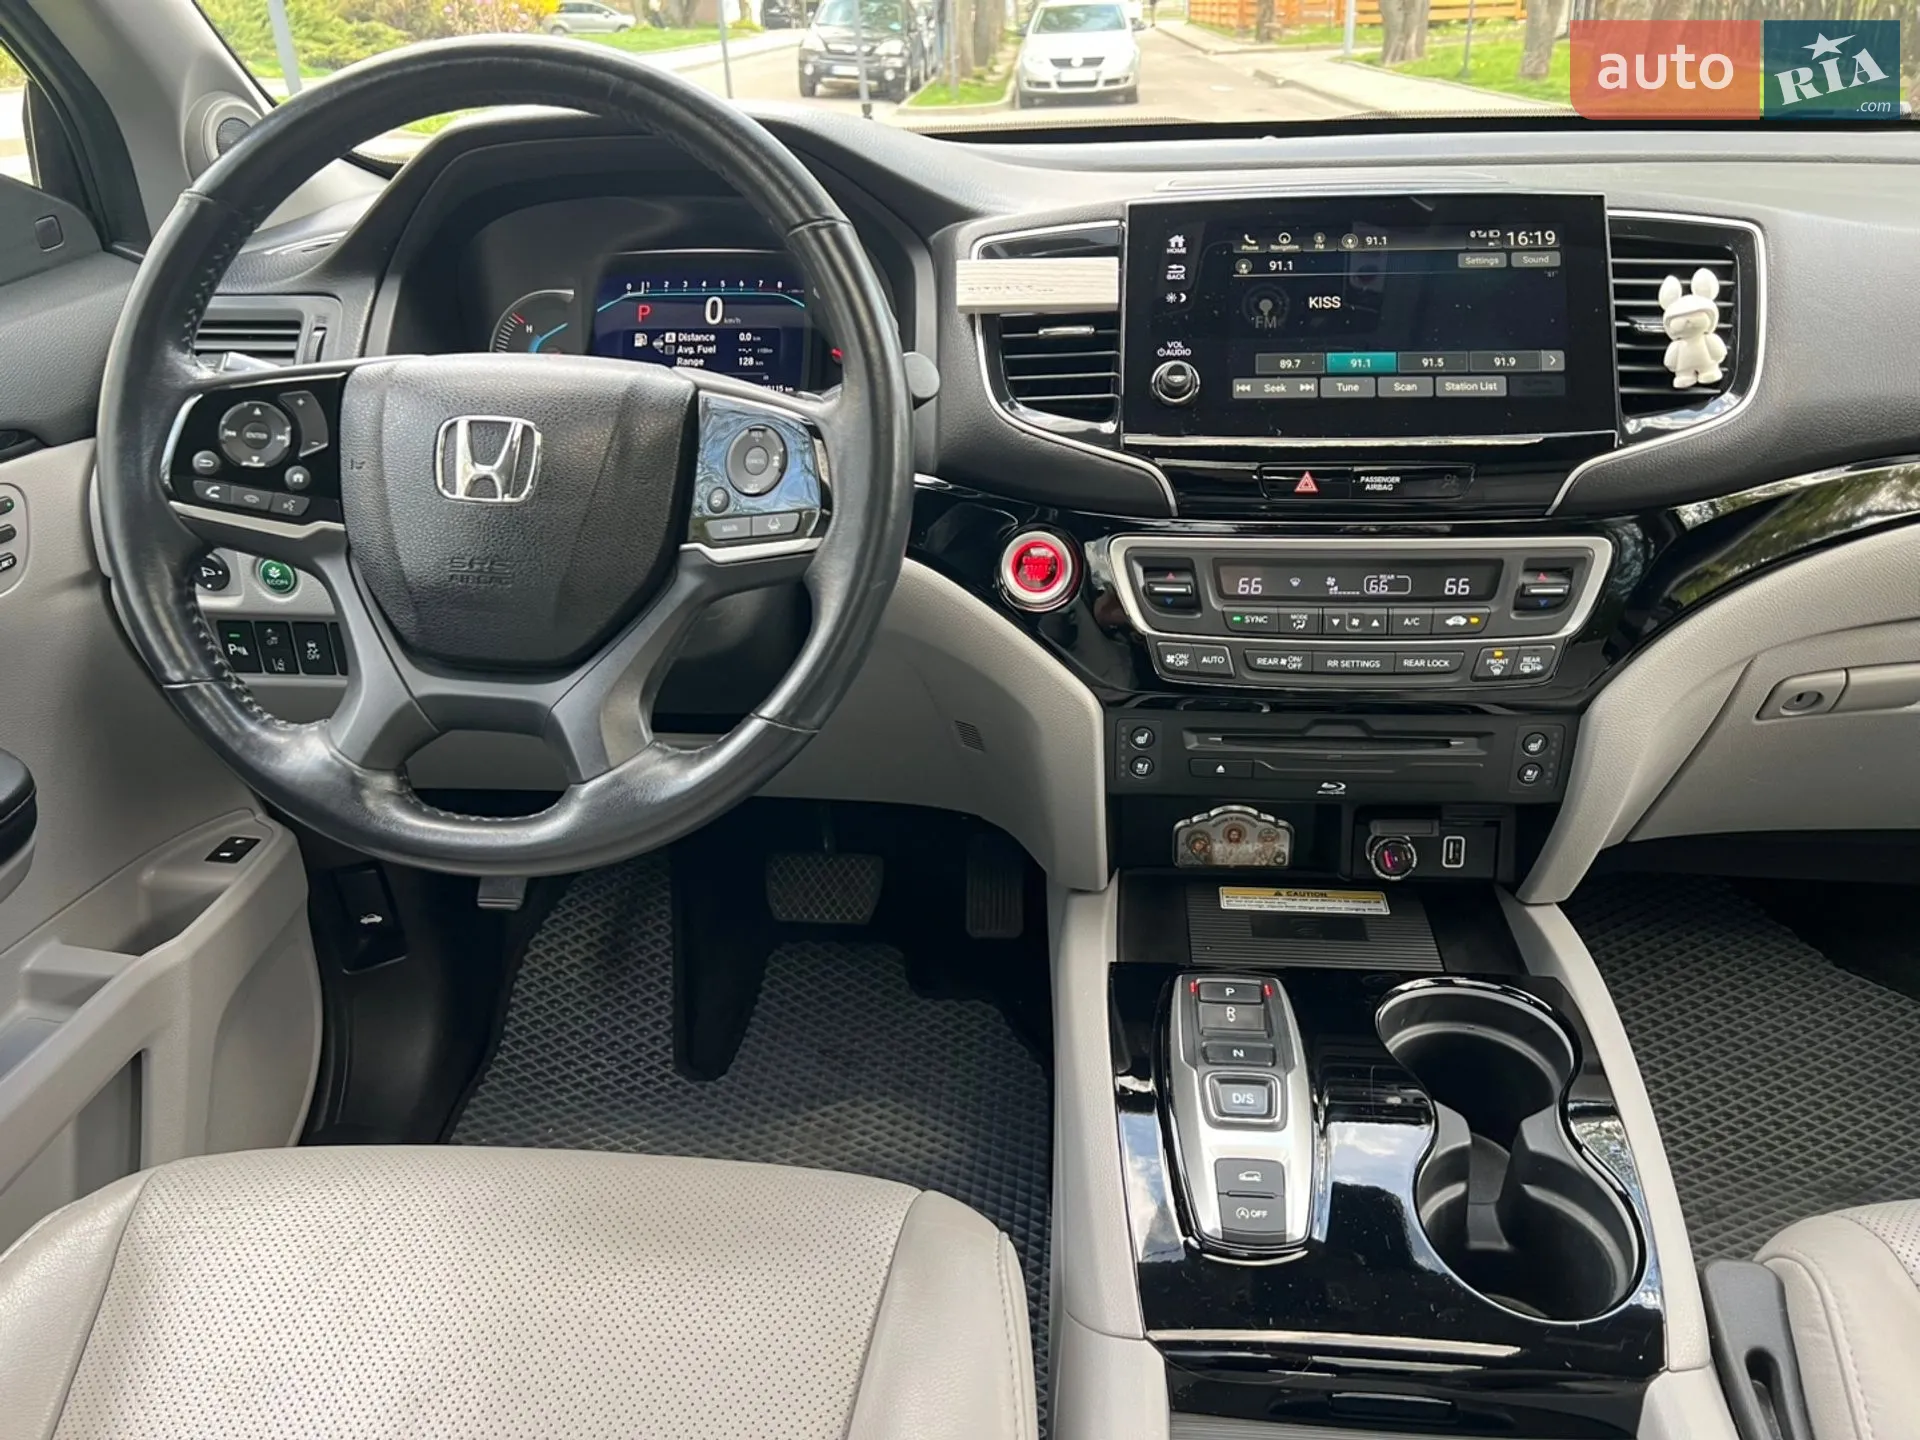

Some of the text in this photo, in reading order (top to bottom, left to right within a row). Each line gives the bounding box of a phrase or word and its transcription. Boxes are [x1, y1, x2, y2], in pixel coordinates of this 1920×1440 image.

[1365, 236, 1388, 246] 91.1
[1506, 230, 1556, 246] 16:19
[1465, 256, 1499, 266] Settings
[1522, 255, 1550, 264] Sound
[1268, 260, 1294, 271] 91.1
[1308, 296, 1342, 309] KISS
[638, 305, 651, 323] P
[704, 296, 724, 325] 0
[1254, 316, 1277, 329] FM
[526, 325, 533, 333] H
[677, 333, 715, 342] Distance
[738, 332, 752, 341] 0.0
[677, 345, 695, 354] Avg.
[697, 345, 716, 353] Fuel
[1166, 341, 1184, 349] VOL
[1165, 348, 1192, 357] AUDIO
[677, 357, 704, 367] Range
[738, 356, 754, 366] 128
[1279, 358, 1301, 369] 89.7
[1350, 358, 1371, 369] 91.1
[1421, 357, 1445, 368] 91.5
[1493, 356, 1517, 367] 91.9
[1263, 383, 1287, 393] Seek
[1335, 382, 1360, 392] Tune
[1393, 381, 1418, 391] Scan
[1445, 381, 1498, 391] Station List
[1360, 476, 1400, 484] PASSENGER
[1237, 577, 1263, 595] 66
[1369, 580, 1389, 593] 66
[1443, 578, 1470, 596] 66
[1244, 615, 1269, 624] SYNC
[1403, 617, 1420, 626] A/C
[1175, 659, 1189, 667] OFF
[1201, 656, 1225, 664] AUTO
[1256, 657, 1279, 666] REAR
[1326, 659, 1381, 669] RR SETTINGS
[1403, 659, 1450, 668] REAR LOCK
[1486, 658, 1509, 666] FRONT
[1523, 656, 1541, 664] REAR
[1287, 662, 1302, 670] OFF
[1286, 890, 1328, 898] CAUTION
[1225, 987, 1236, 997] P
[1226, 1006, 1236, 1017] R
[1233, 1048, 1245, 1058] N
[1232, 1091, 1255, 1106] D/S
[1250, 1210, 1269, 1219] OFF
